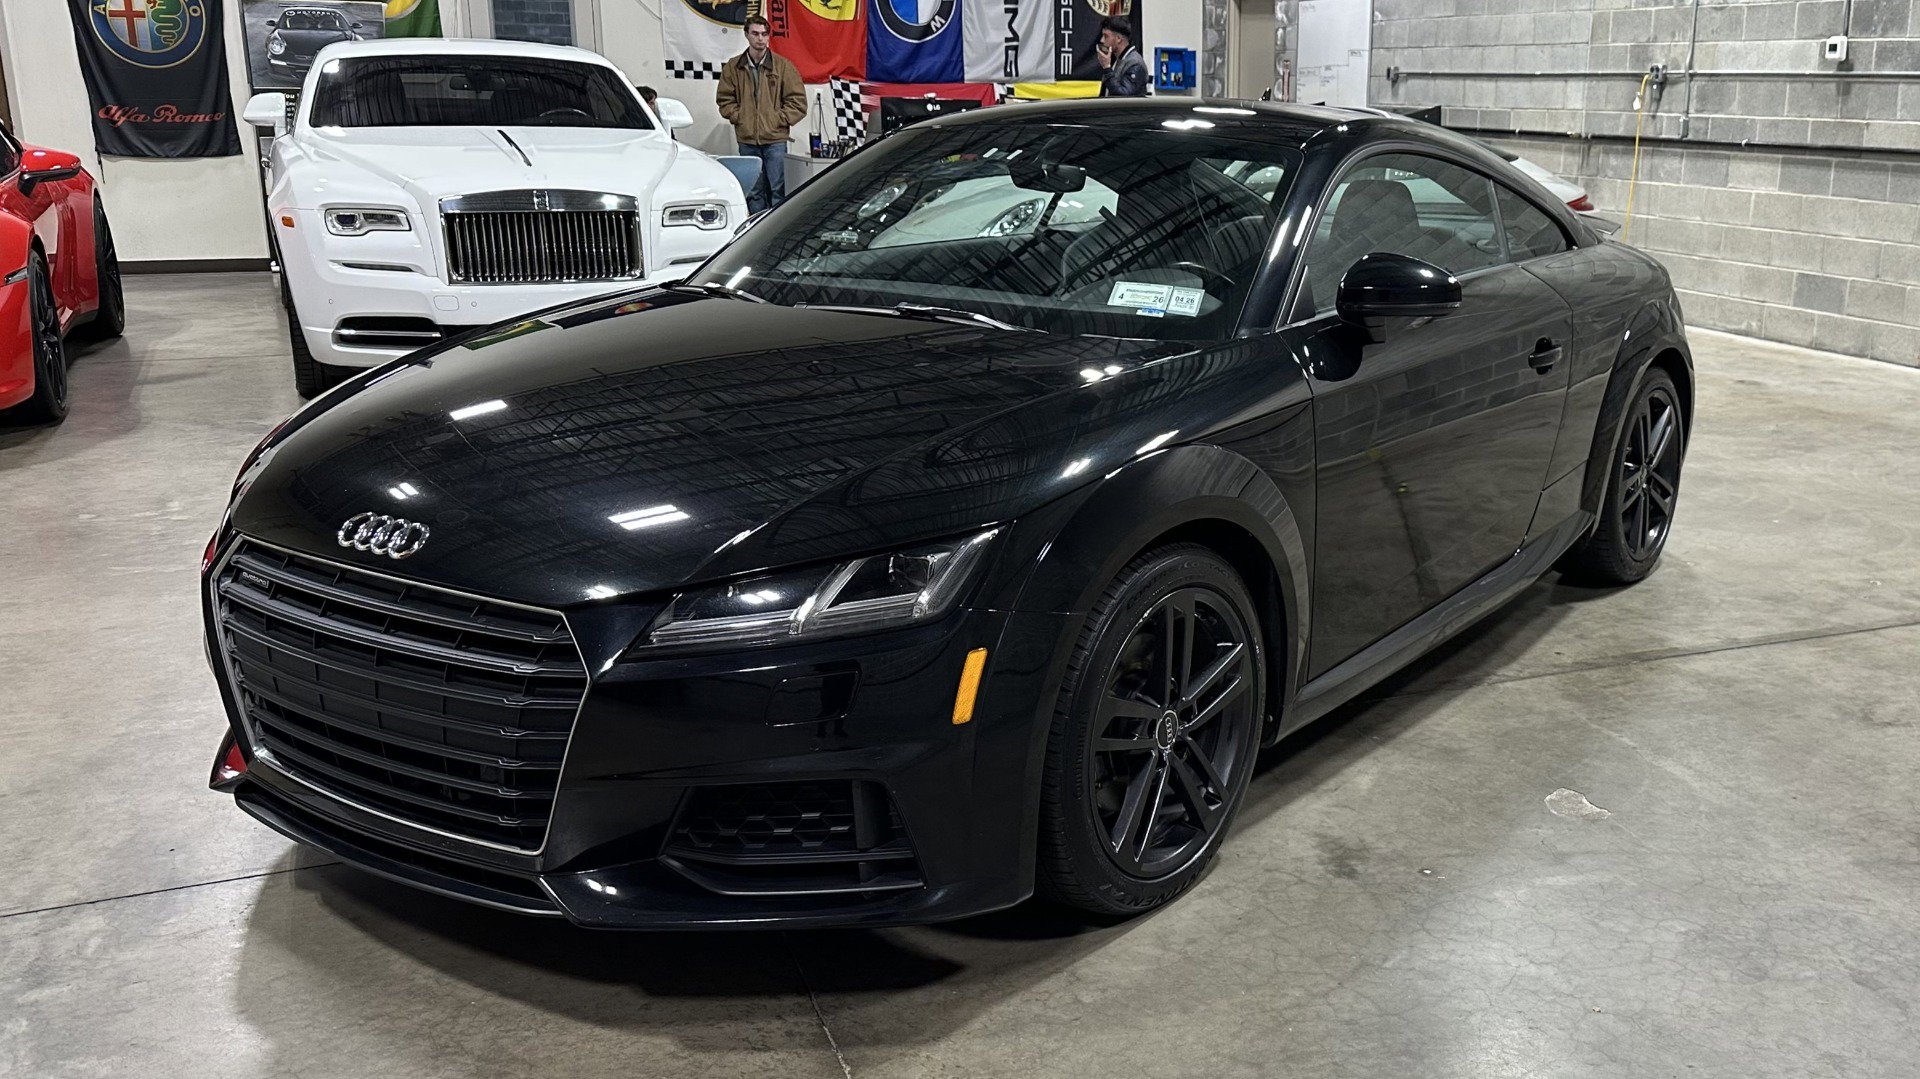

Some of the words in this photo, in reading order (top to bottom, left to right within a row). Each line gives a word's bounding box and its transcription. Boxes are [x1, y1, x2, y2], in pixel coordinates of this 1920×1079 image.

[1003, 0, 1020, 78] MG
[98, 104, 150, 128] Alfa
[152, 104, 226, 123] Romeo
[1152, 295, 1165, 304] 26
